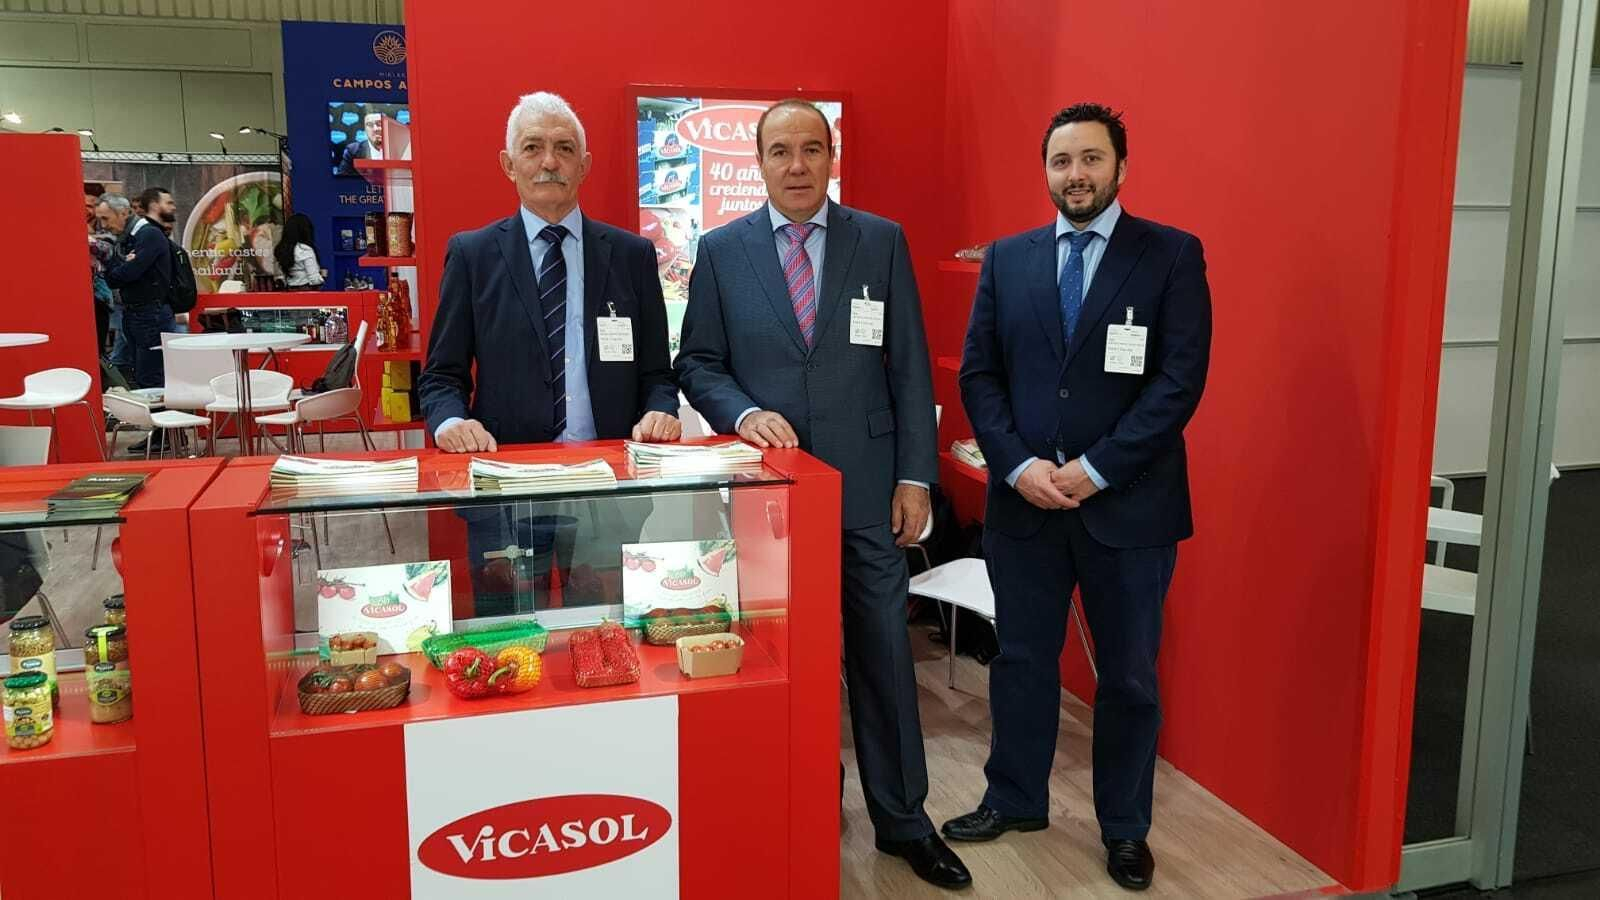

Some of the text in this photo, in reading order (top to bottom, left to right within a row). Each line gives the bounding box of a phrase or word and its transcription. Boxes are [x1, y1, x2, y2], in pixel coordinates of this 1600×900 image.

[333, 78, 392, 90] CAMPOS
[709, 161, 764, 182] 40 añ
[340, 194, 357, 205] THE
